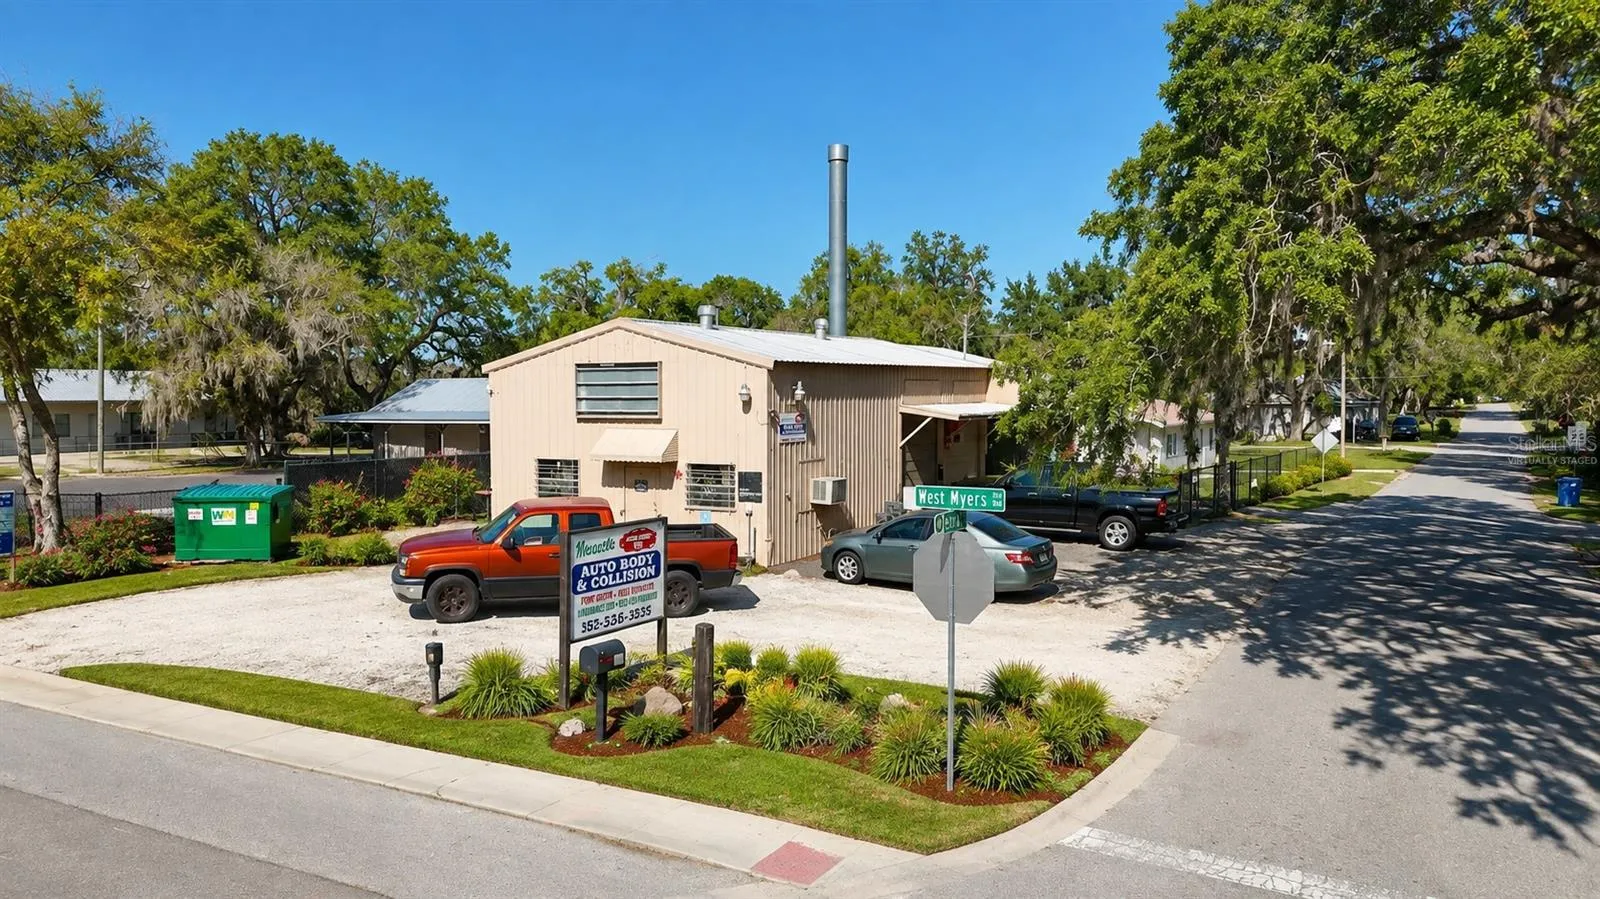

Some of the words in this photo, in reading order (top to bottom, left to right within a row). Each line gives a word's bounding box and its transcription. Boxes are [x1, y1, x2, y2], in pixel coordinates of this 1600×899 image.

[918, 489, 945, 505] West
[950, 490, 987, 508] Myers
[212, 510, 235, 520] WM
[580, 560, 616, 578] AUTO
[620, 553, 655, 570] BODY
[576, 580, 587, 592] &
[591, 565, 656, 588] COLLISION
